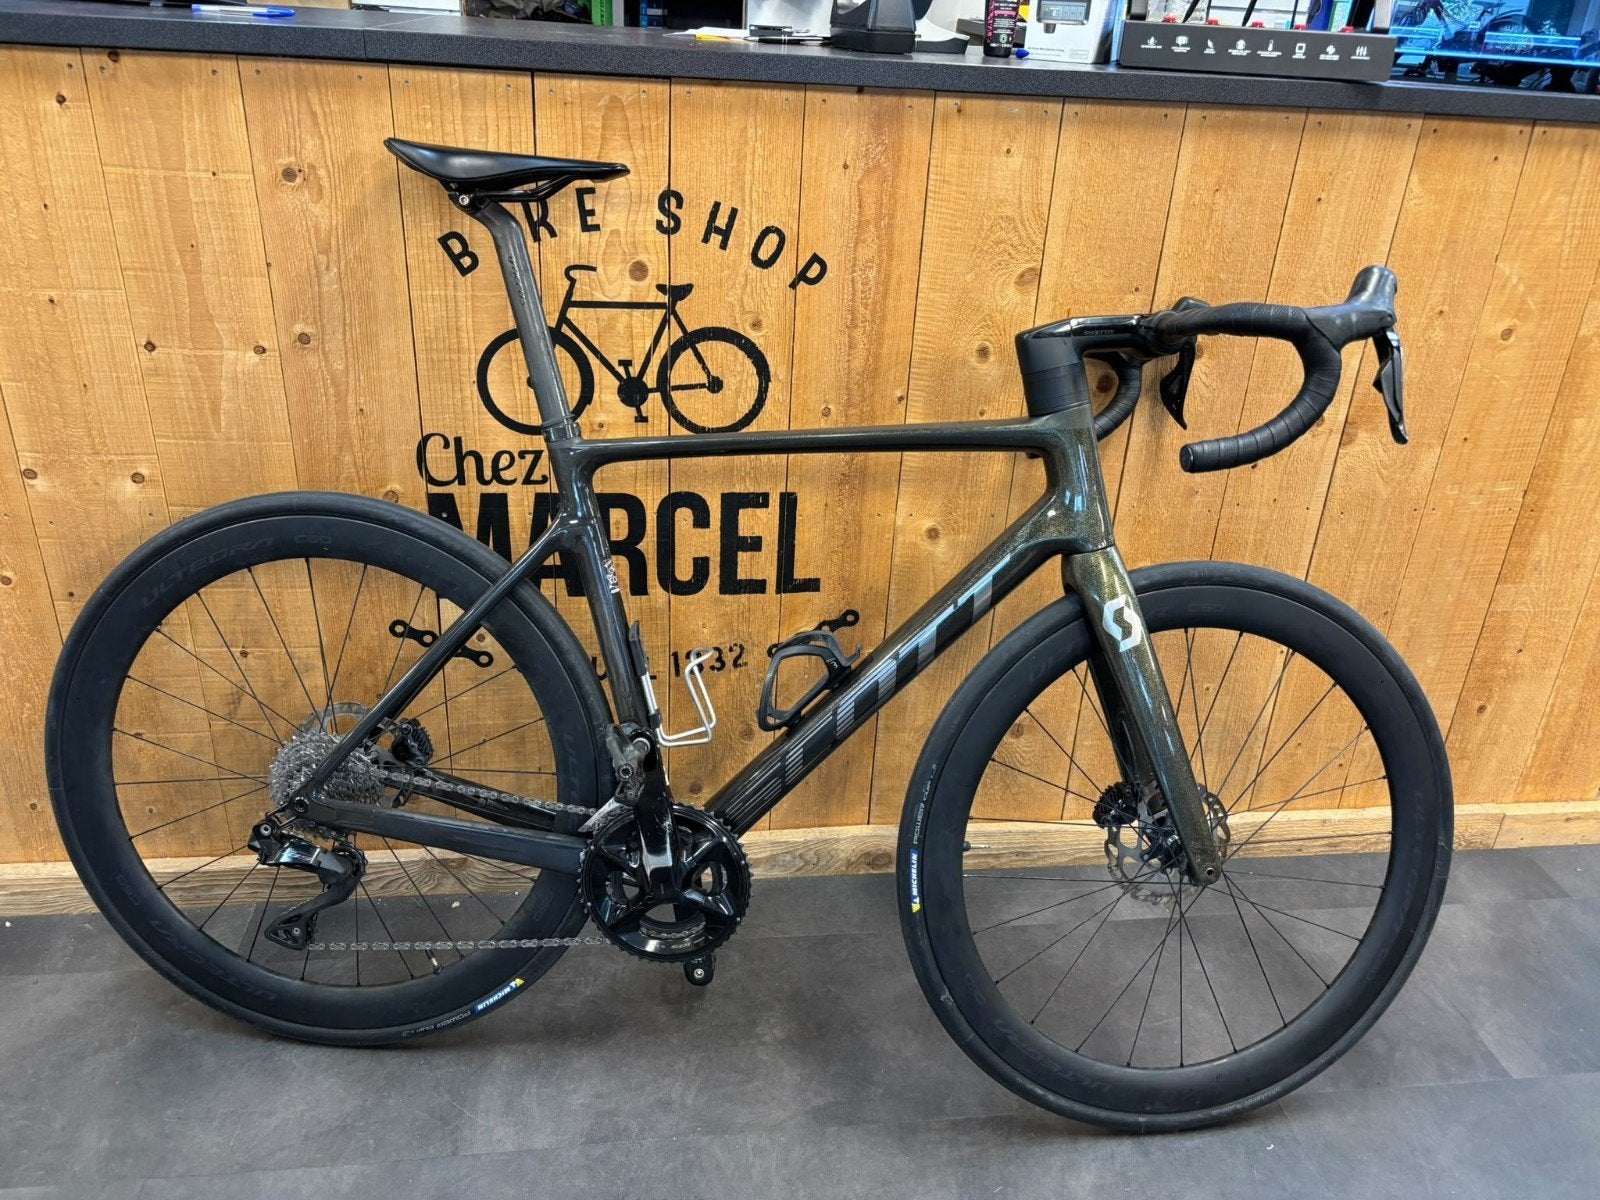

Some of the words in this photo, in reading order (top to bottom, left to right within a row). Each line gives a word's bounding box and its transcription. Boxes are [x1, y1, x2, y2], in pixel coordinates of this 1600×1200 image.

[437, 186, 601, 277] BKE
[655, 189, 829, 291] SHOP
[416, 432, 549, 487] Chez
[425, 491, 821, 597] MARCEL
[922, 780, 932, 802] CUP
[913, 803, 925, 845] POWER
[911, 852, 919, 896] MICHELIN
[436, 1010, 472, 1029] POWER
